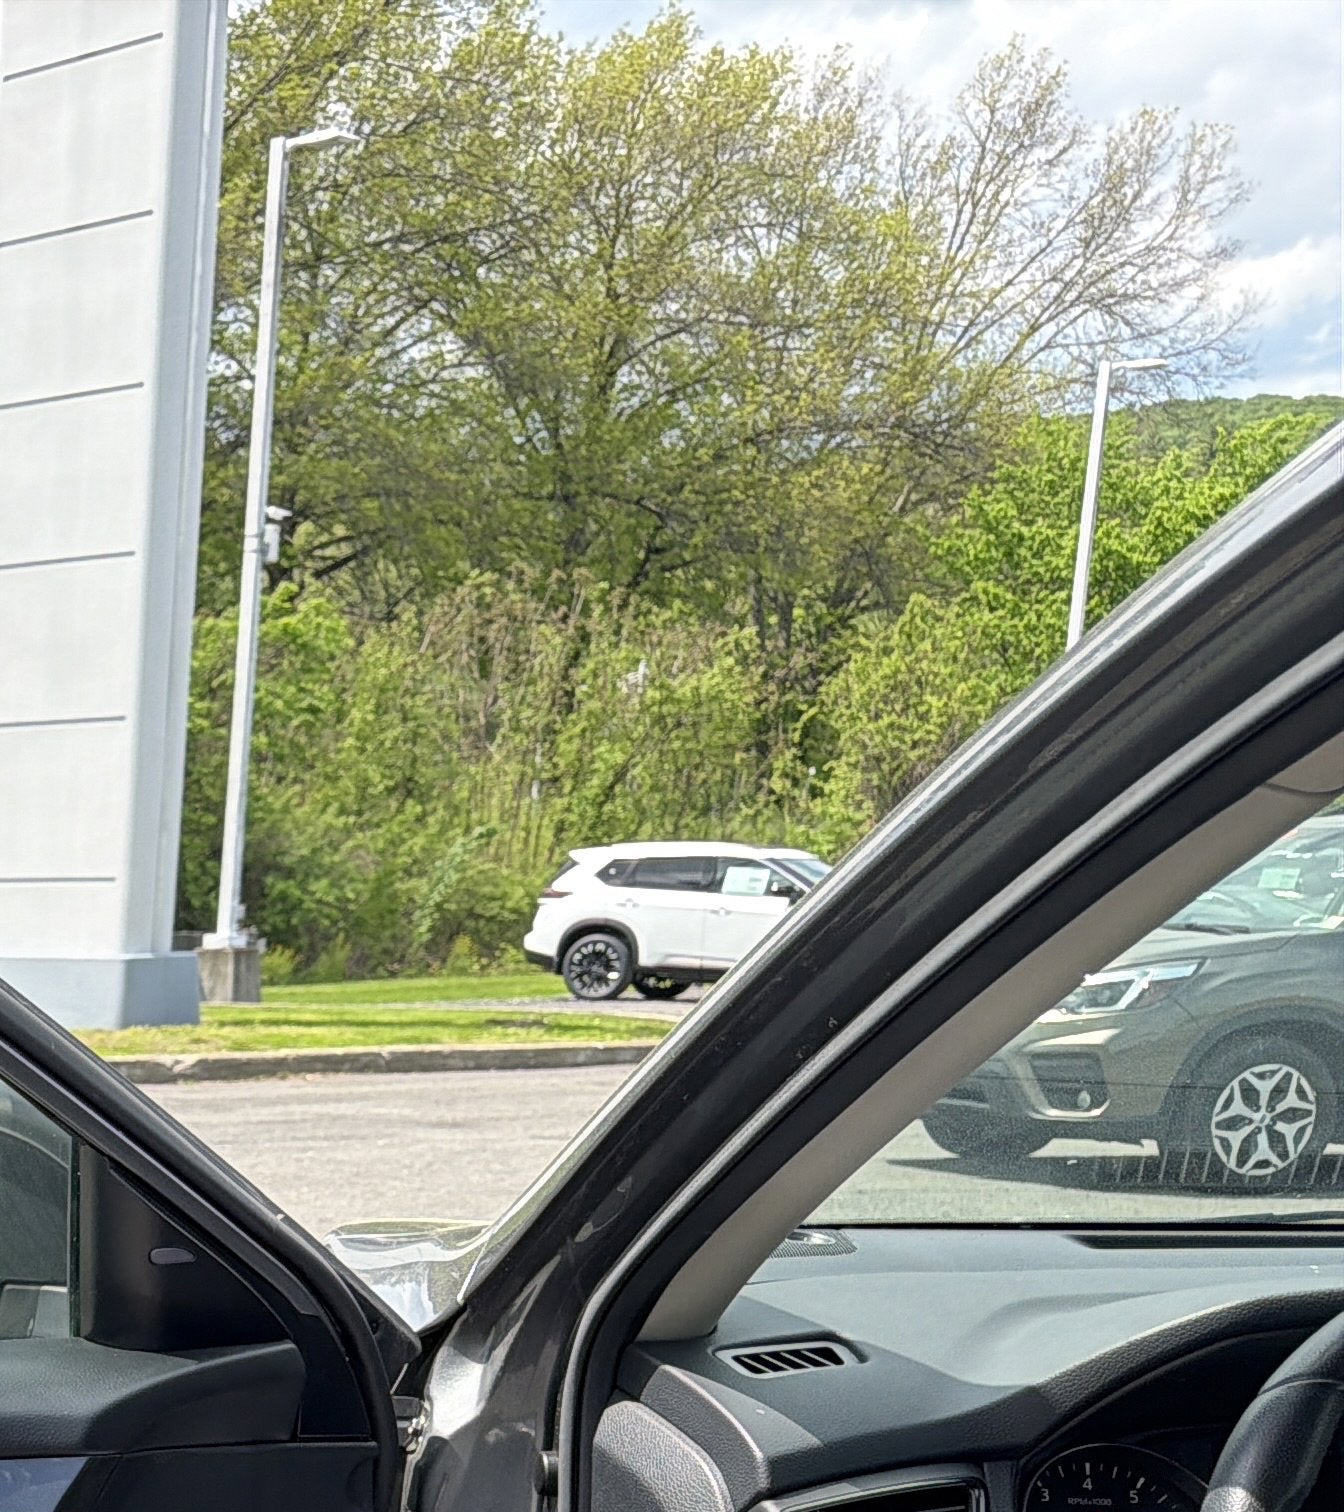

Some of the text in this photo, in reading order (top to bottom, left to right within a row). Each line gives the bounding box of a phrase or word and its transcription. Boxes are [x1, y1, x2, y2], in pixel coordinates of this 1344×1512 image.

[1082, 1479, 1093, 1491] 4
[1040, 1488, 1050, 1502] 3
[1129, 1490, 1139, 1504] 5
